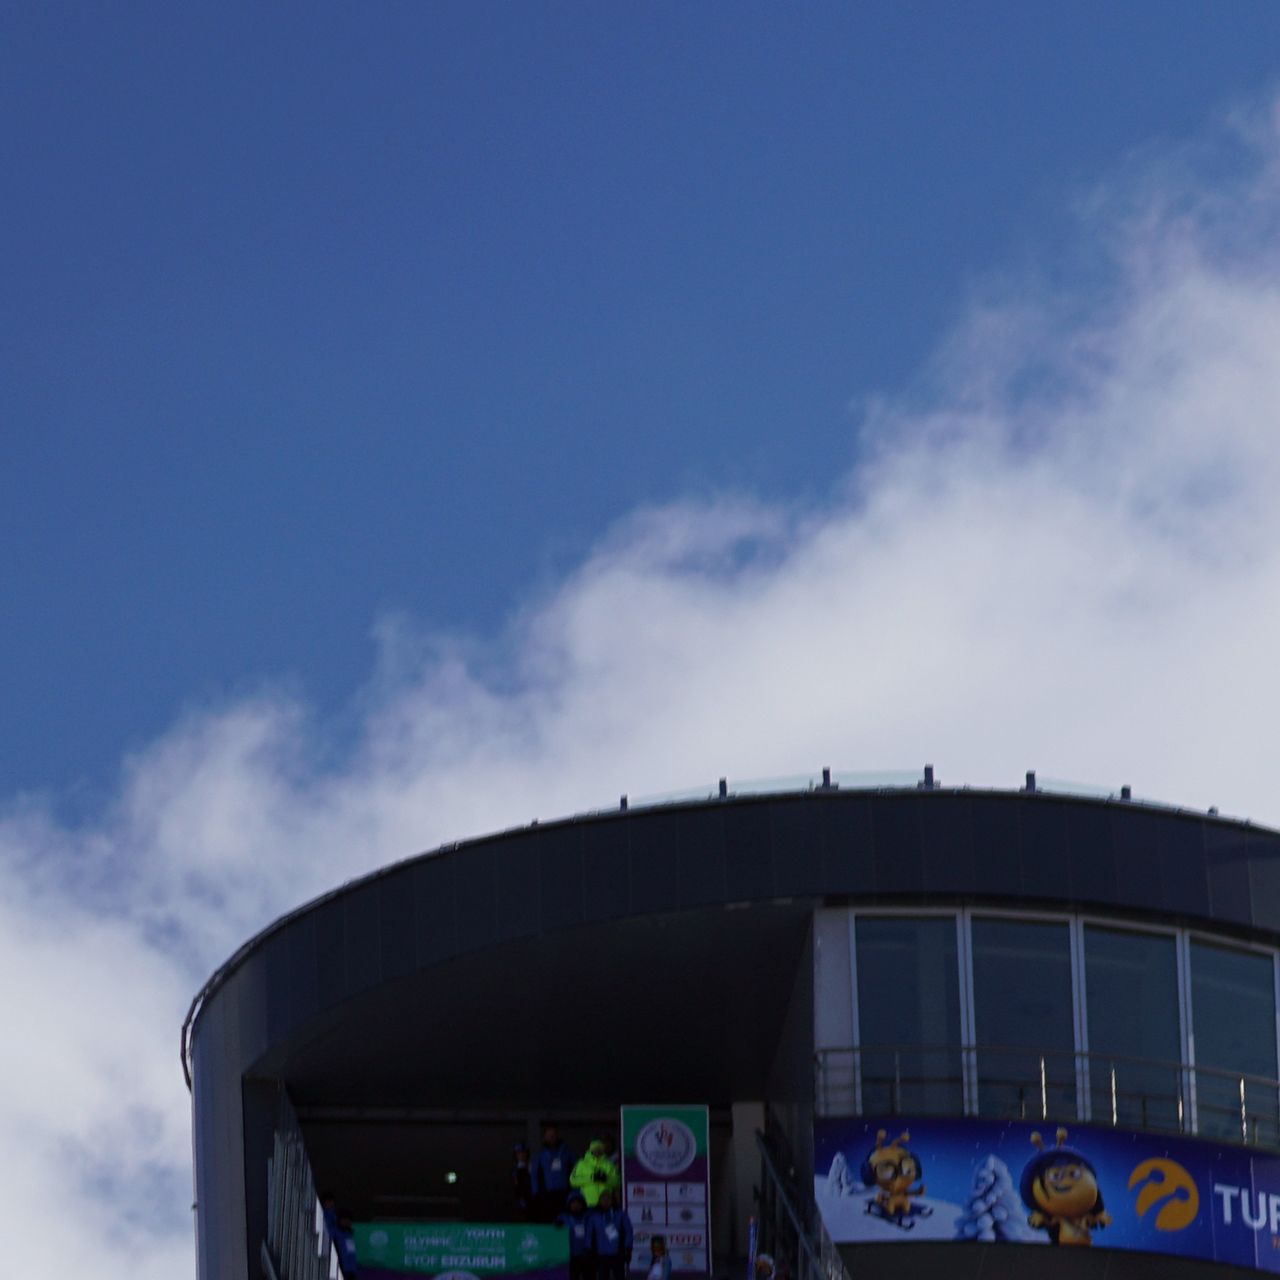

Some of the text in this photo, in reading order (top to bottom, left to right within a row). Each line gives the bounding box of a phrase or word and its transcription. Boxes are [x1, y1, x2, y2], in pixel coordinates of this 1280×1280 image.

[463, 1228, 506, 1240] YOUTH
[403, 1236, 451, 1248] OLYMPIC
[404, 1254, 506, 1269] EYOF ERZURUM
